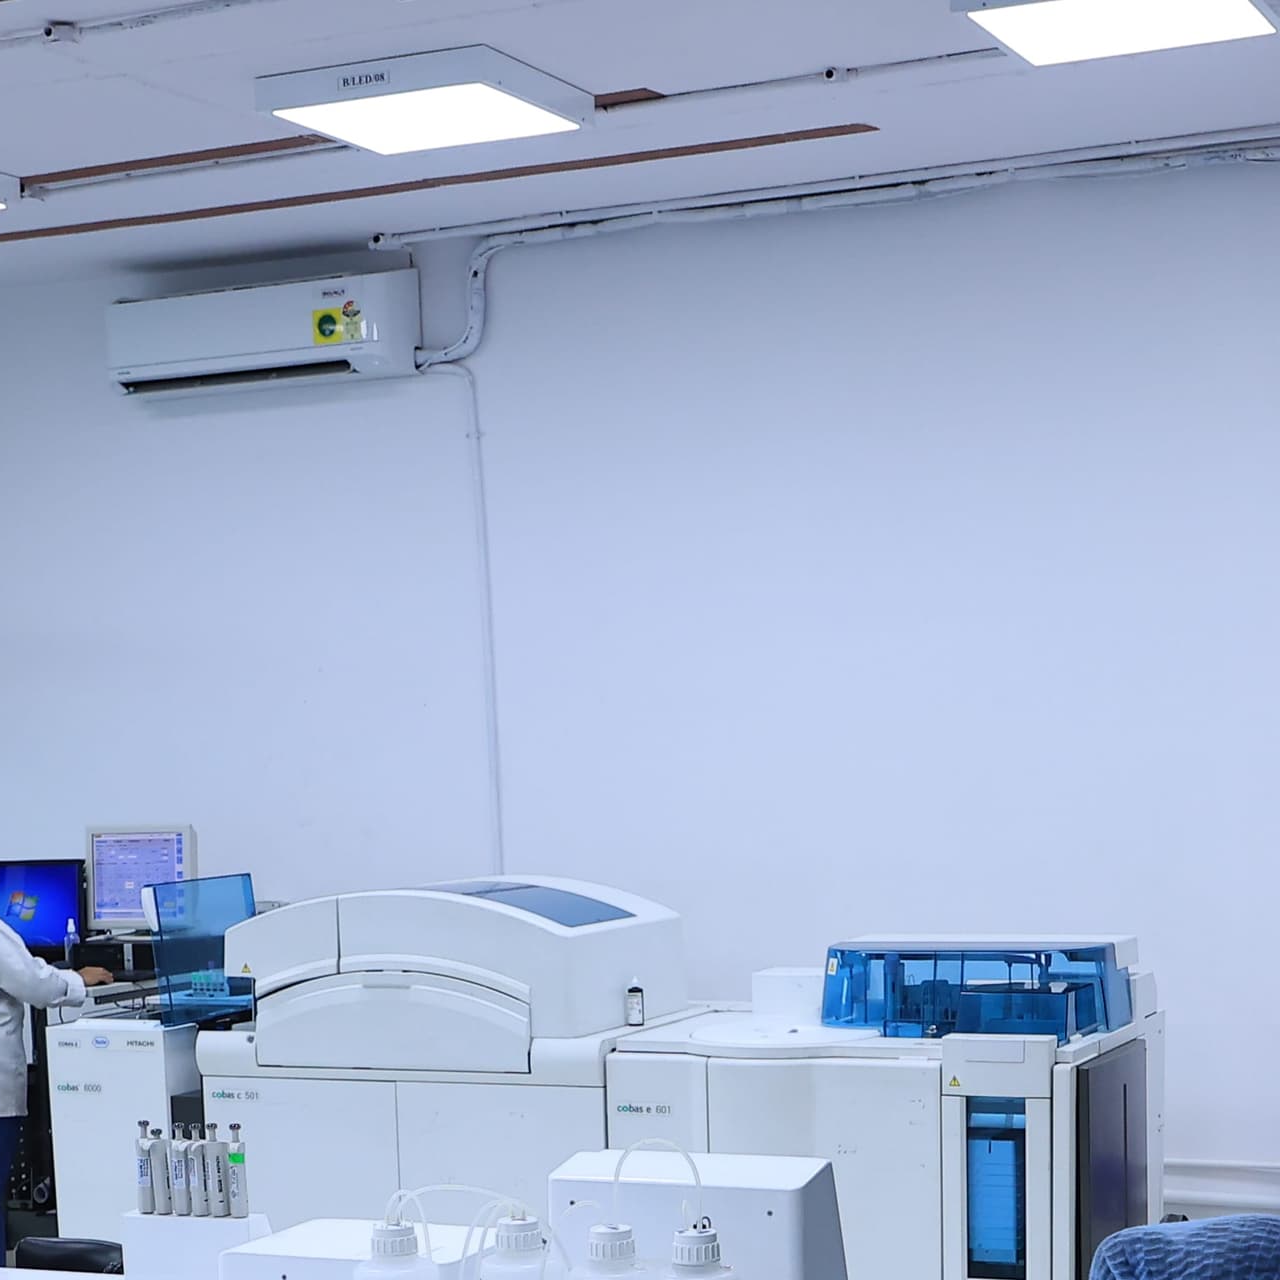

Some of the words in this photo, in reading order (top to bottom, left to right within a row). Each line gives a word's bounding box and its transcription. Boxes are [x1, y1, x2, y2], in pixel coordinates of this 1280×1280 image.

[57, 1083, 79, 1091] cobas
[212, 1090, 235, 1099] cobas
[244, 1091, 259, 1100] 501
[617, 1104, 643, 1113] cobas
[655, 1105, 671, 1114] 601
